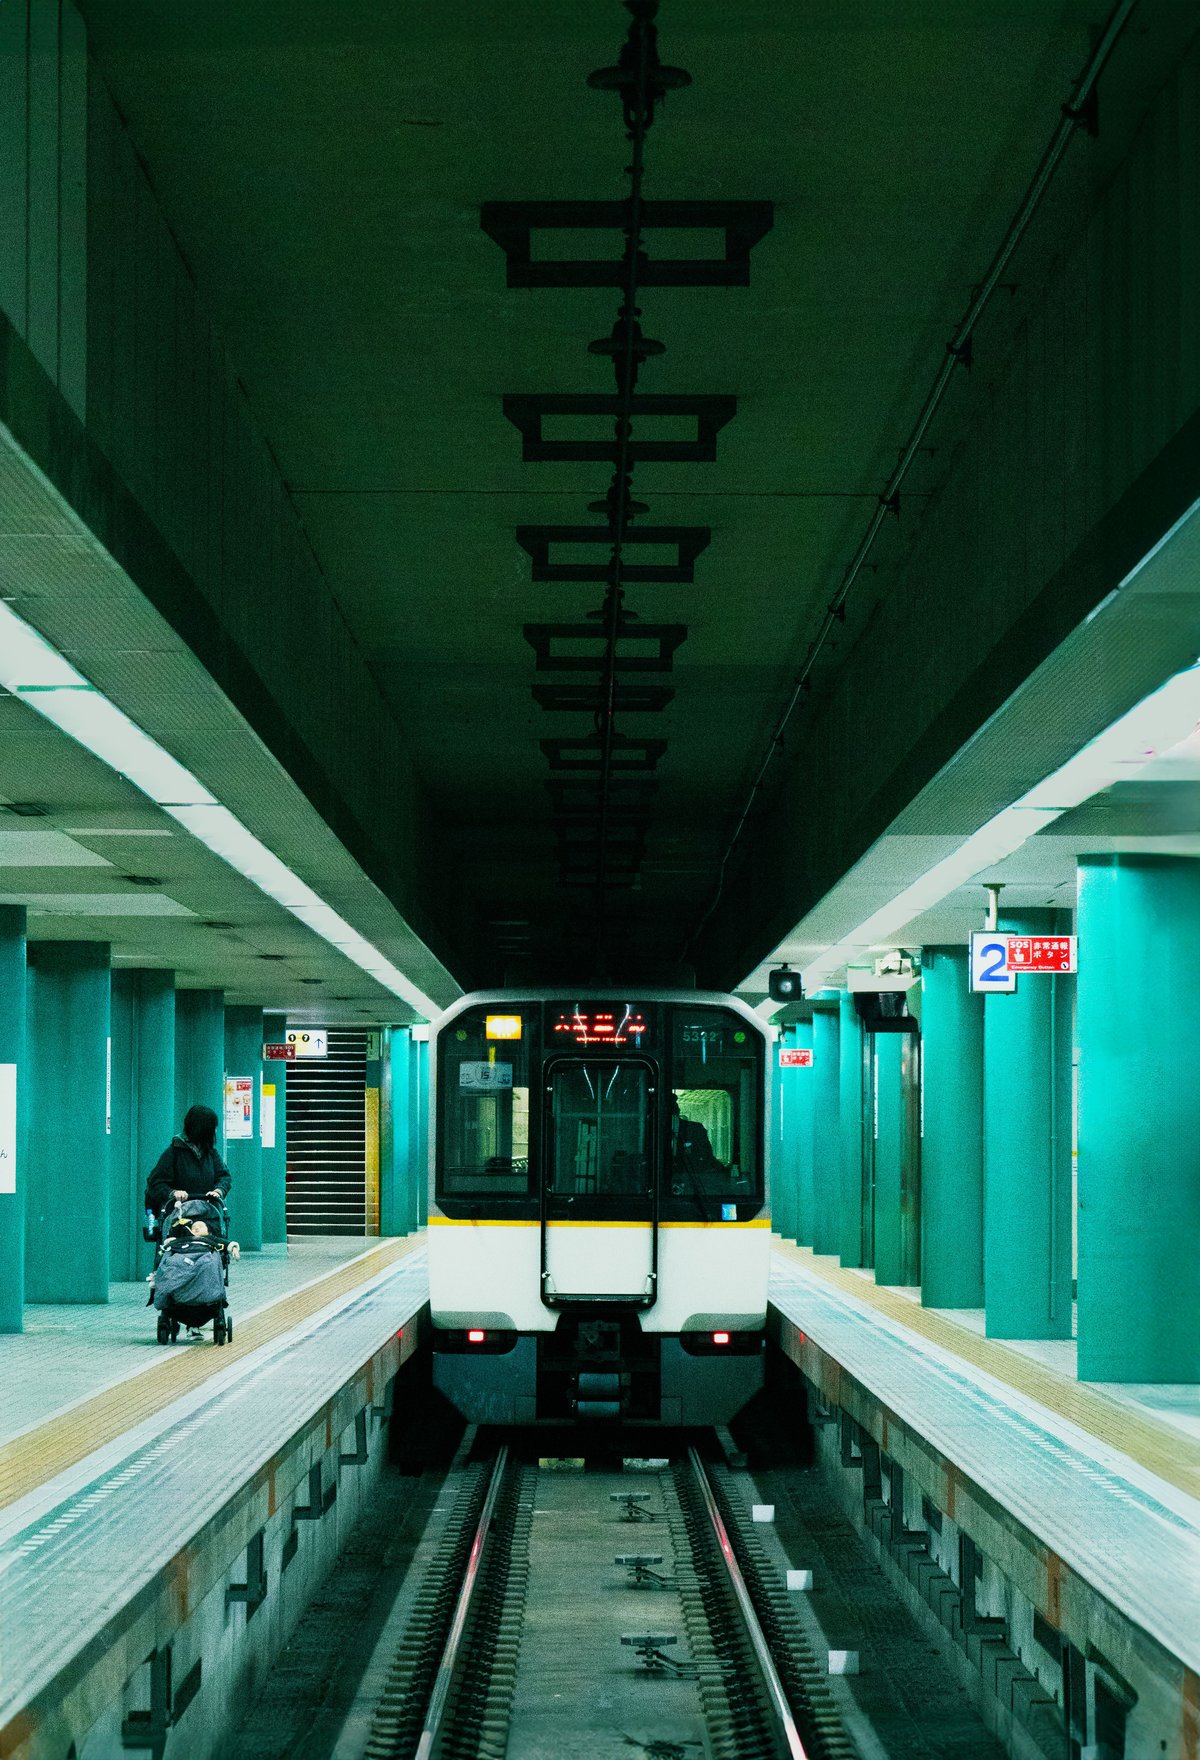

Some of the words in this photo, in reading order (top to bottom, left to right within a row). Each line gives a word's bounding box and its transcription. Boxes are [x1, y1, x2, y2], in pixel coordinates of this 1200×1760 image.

[1033, 942, 1068, 950] 非常通報
[980, 944, 1009, 981] 2
[682, 1031, 716, 1042] 5322
